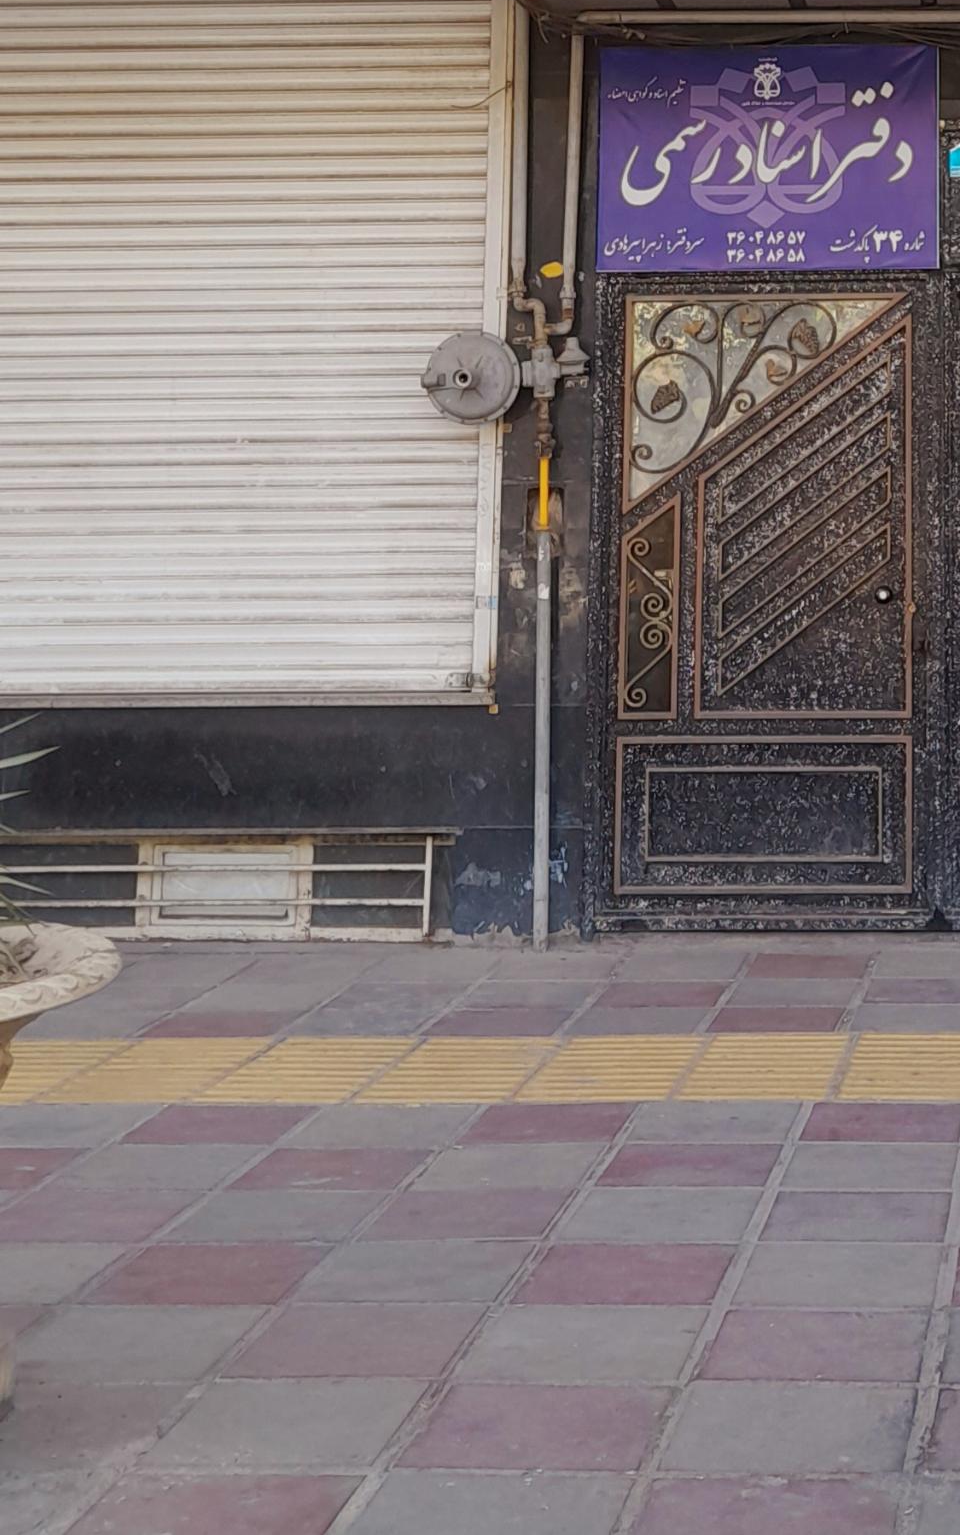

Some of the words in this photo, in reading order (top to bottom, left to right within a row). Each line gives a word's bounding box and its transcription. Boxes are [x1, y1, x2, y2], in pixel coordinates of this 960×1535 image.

[620, 119, 721, 206] رسمی
[728, 120, 823, 184] اسناد
[806, 82, 914, 203] دفتر
[872, 229, 903, 253] ۳۴
[904, 231, 925, 252] شماره
